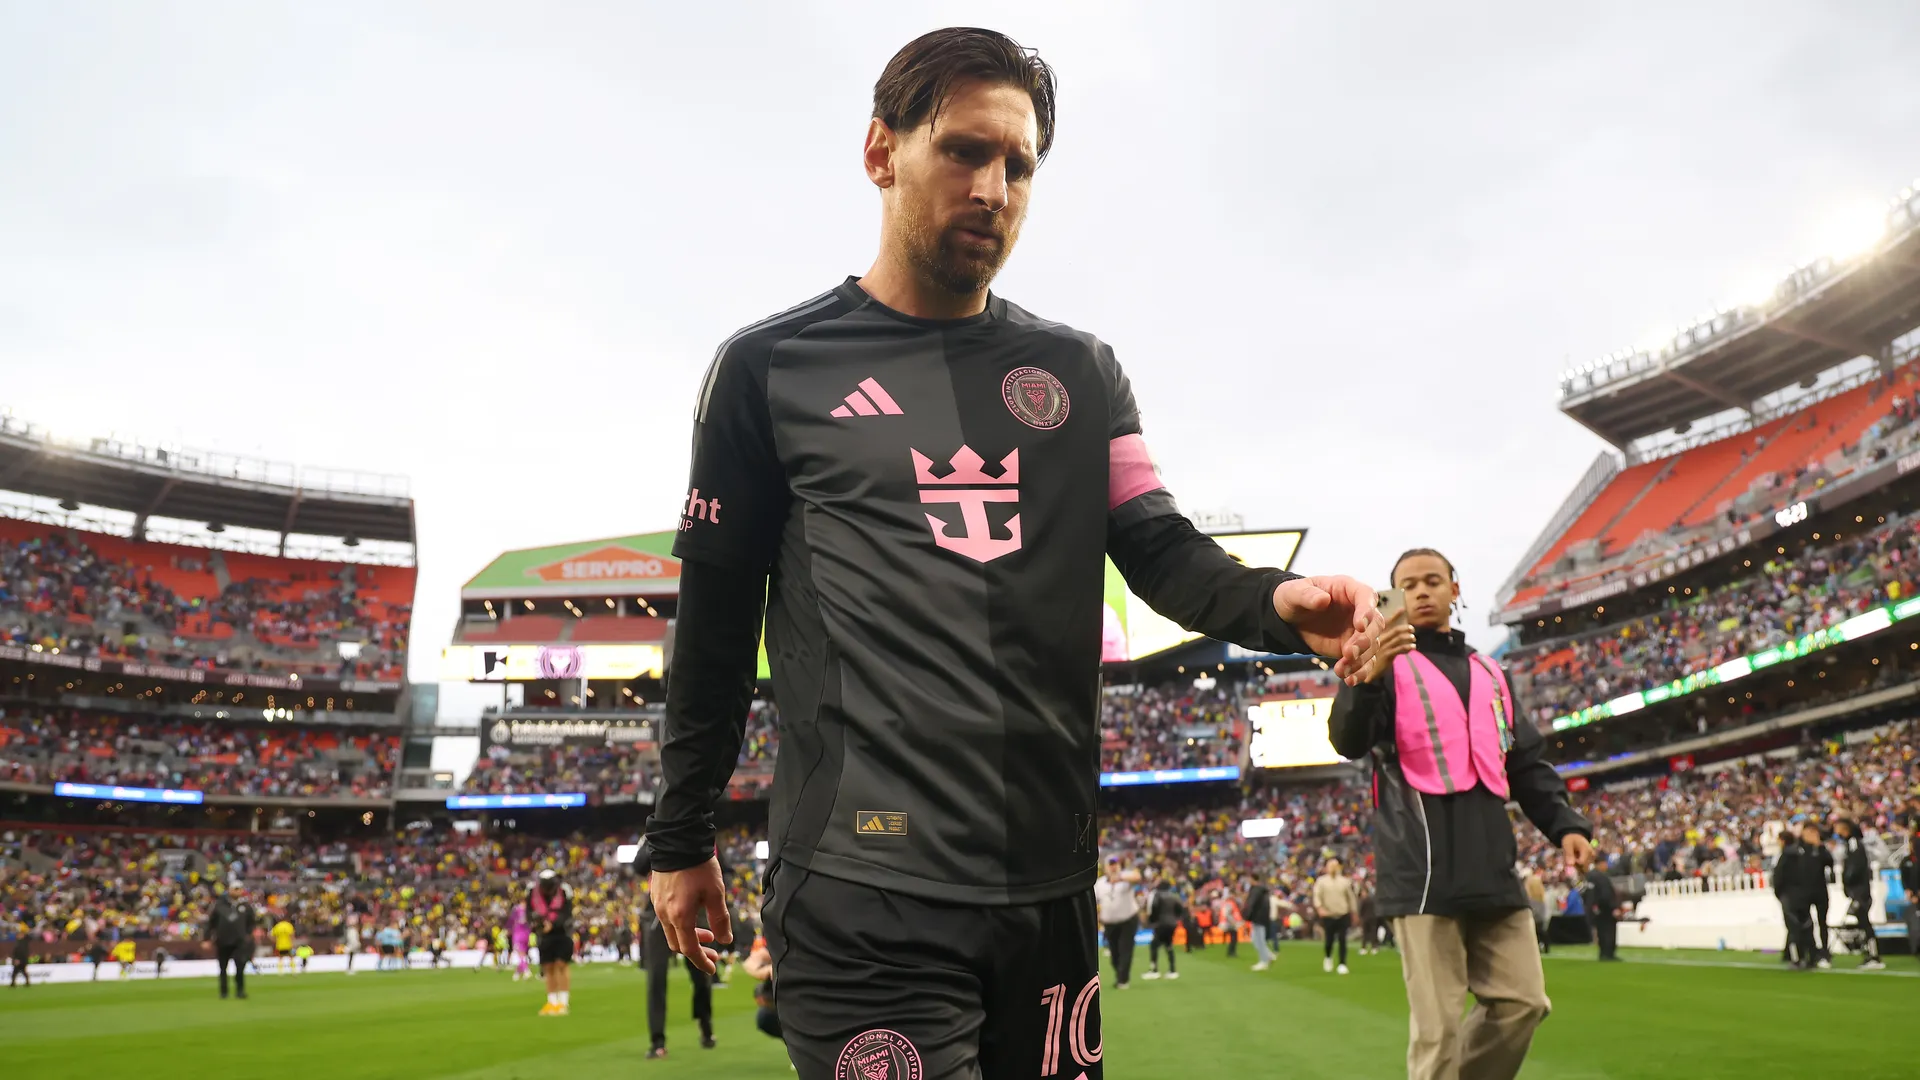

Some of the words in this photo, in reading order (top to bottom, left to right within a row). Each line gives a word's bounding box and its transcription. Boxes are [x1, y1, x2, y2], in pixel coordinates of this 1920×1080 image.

[682, 487, 722, 524] ht
[562, 559, 663, 578] SERVPRO
[1040, 974, 1103, 1077] 10
[840, 1033, 894, 1079] NTERNACIONAL
[896, 1039, 908, 1051] DE
[906, 1051, 918, 1080] FÚTBO
[857, 1049, 889, 1067] MIAMI
